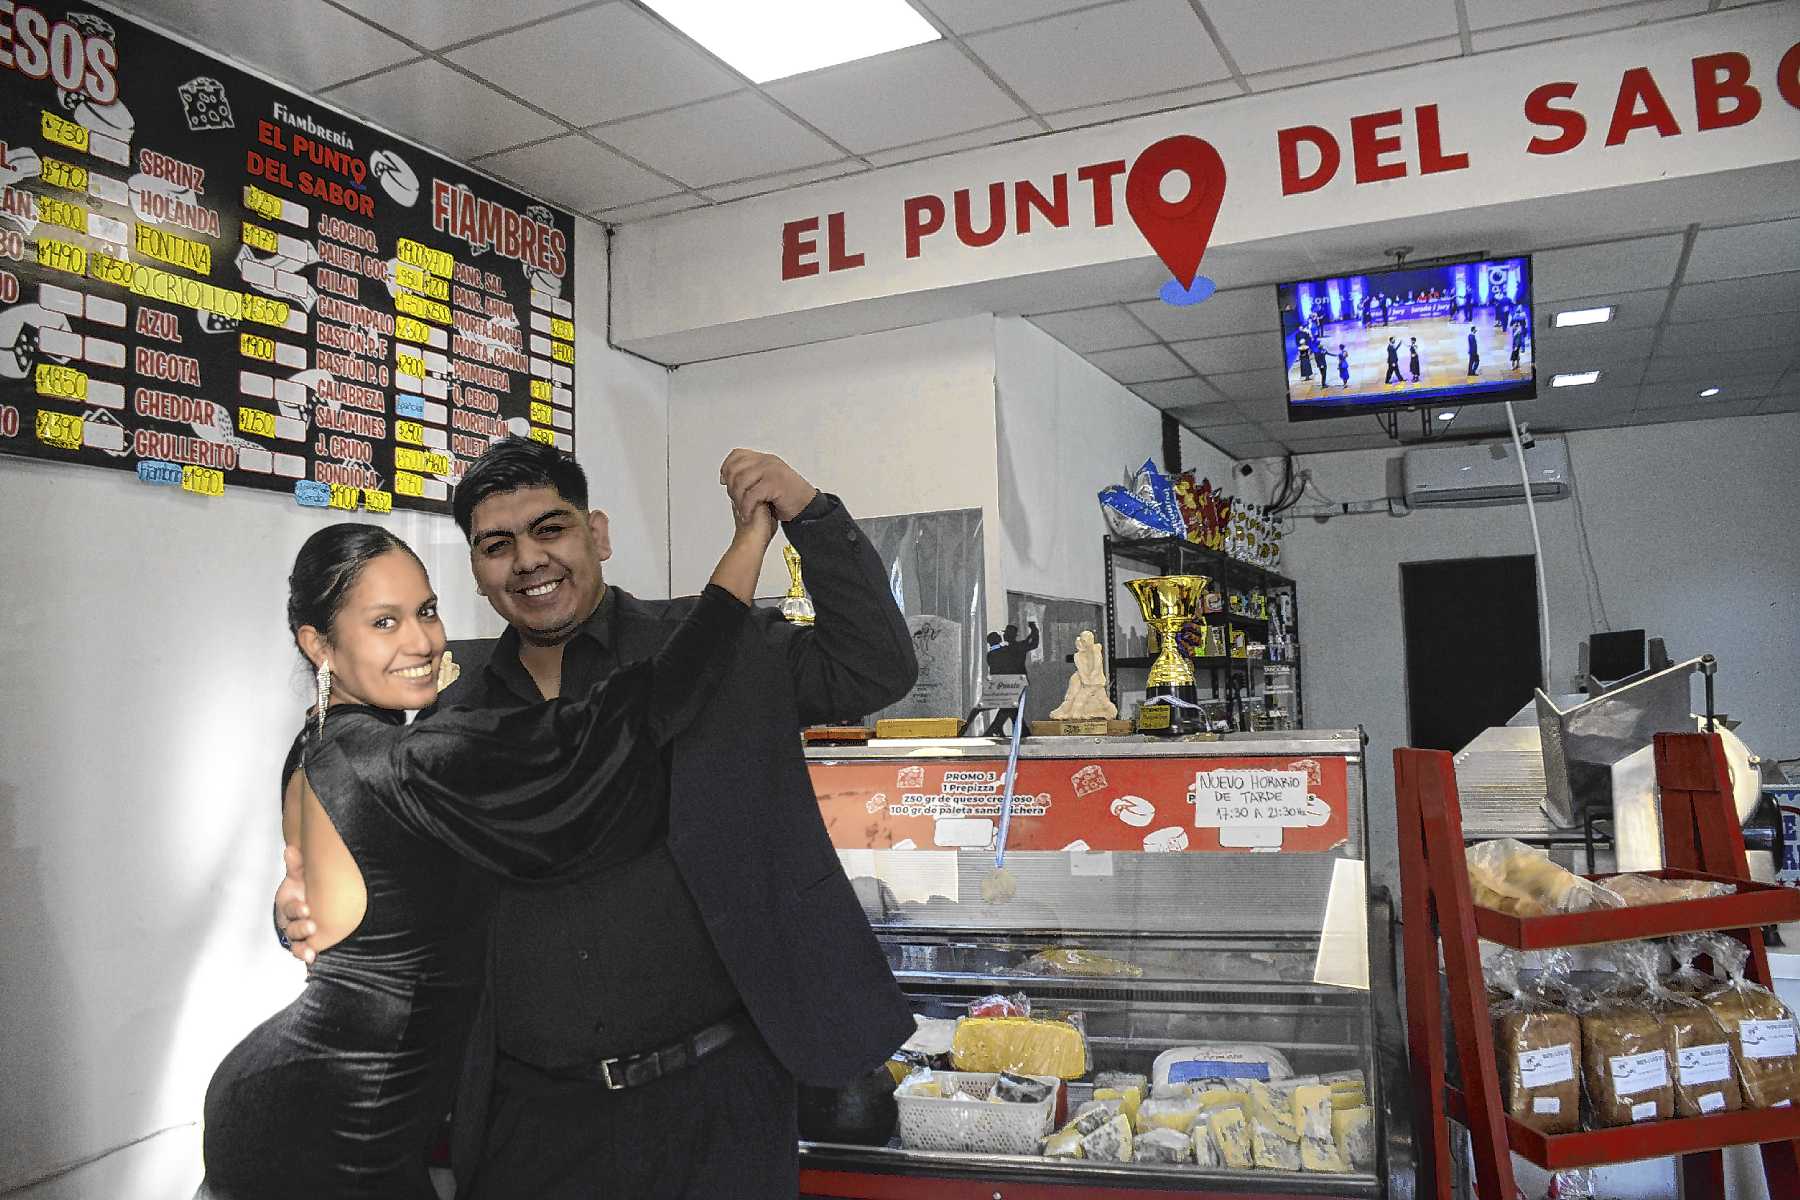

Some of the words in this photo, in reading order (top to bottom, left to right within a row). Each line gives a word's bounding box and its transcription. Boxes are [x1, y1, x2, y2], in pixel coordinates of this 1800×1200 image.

[258, 120, 287, 151] EL
[140, 149, 205, 194] SBRINZ
[247, 150, 293, 188] DEL
[298, 171, 374, 219] SABOR
[782, 211, 865, 281] EL
[1277, 104, 1469, 196] DEL
[140, 190, 220, 238] HOLANDA
[433, 178, 566, 278] FIAMBRES
[140, 226, 208, 271] FONTINA
[153, 272, 238, 317] CRIOLLO
[136, 307, 182, 343] AZUL
[317, 294, 394, 336] CANTIMPALO
[136, 347, 200, 387] RICOTA
[135, 388, 215, 427] CHEDDAR
[315, 404, 386, 439] SALAMINES
[135, 430, 236, 470] GRULLERITO
[330, 435, 372, 463] CRUDO
[314, 460, 377, 492] BONDIOLA
[945, 772, 985, 781] PROMO
[989, 772, 995, 780] 3
[950, 784, 995, 793] Prepizza
[1200, 773, 1244, 790] NUEVO
[890, 807, 909, 815] 100
[911, 808, 922, 817] gr
[939, 807, 973, 816] paleta
[975, 807, 1044, 815] sandichera
[925, 797, 936, 805] gr
[953, 797, 985, 805] queso
[1215, 792, 1231, 802] DE
[1240, 790, 1284, 804] TARDE
